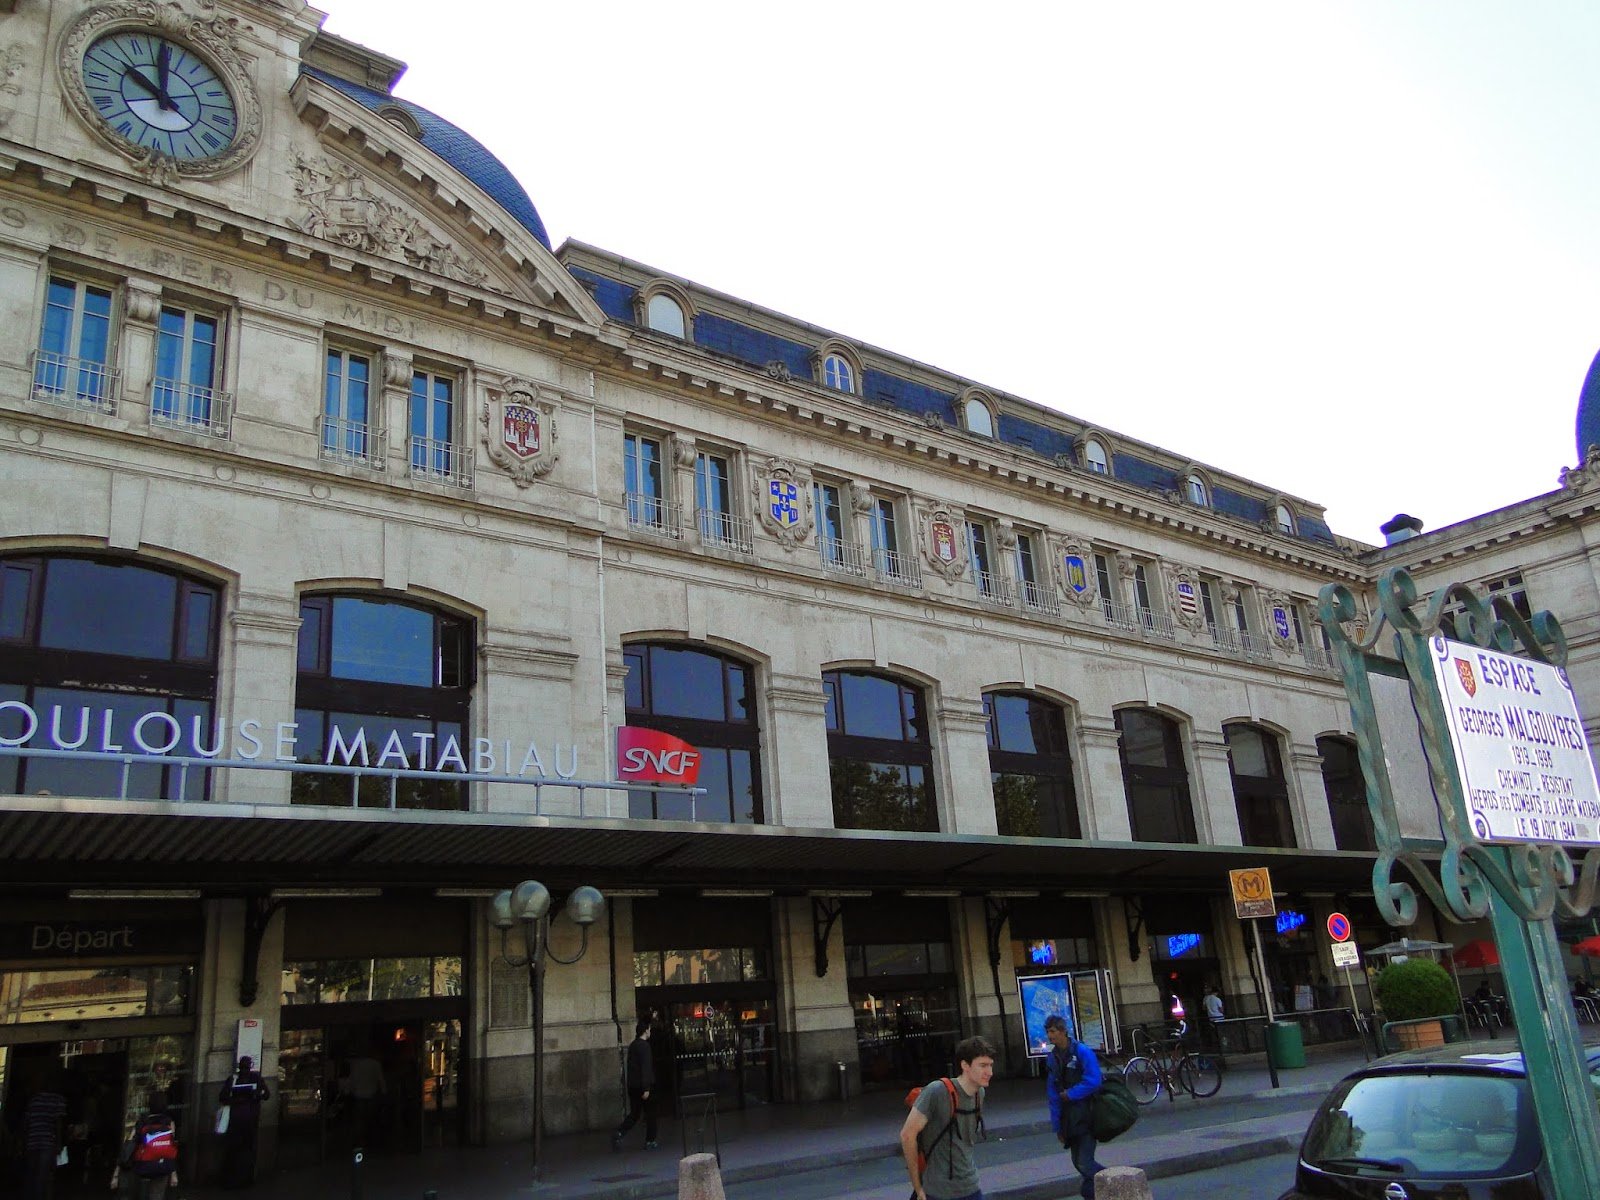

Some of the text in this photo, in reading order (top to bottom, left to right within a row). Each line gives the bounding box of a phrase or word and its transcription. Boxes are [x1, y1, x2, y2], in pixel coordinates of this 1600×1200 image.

[264, 280, 315, 309] DU
[342, 303, 415, 340] MIDI
[1477, 653, 1541, 696] ESPACE
[0, 700, 578, 779] OULOUSE MATABIAU
[1459, 704, 1584, 751] GEORGES MALGOUYRES
[622, 747, 699, 776] SNCF
[1498, 769, 1533, 791] CHEMINOT
[1541, 774, 1575, 796] RESISTANT
[1472, 788, 1499, 810] HEROS
[1511, 792, 1542, 814] COMBATS
[1559, 797, 1577, 817] GARE
[1516, 817, 1528, 837] LE
[1530, 818, 1540, 838] 19
[1560, 820, 1576, 840] 1944
[32, 924, 134, 953] Départ
